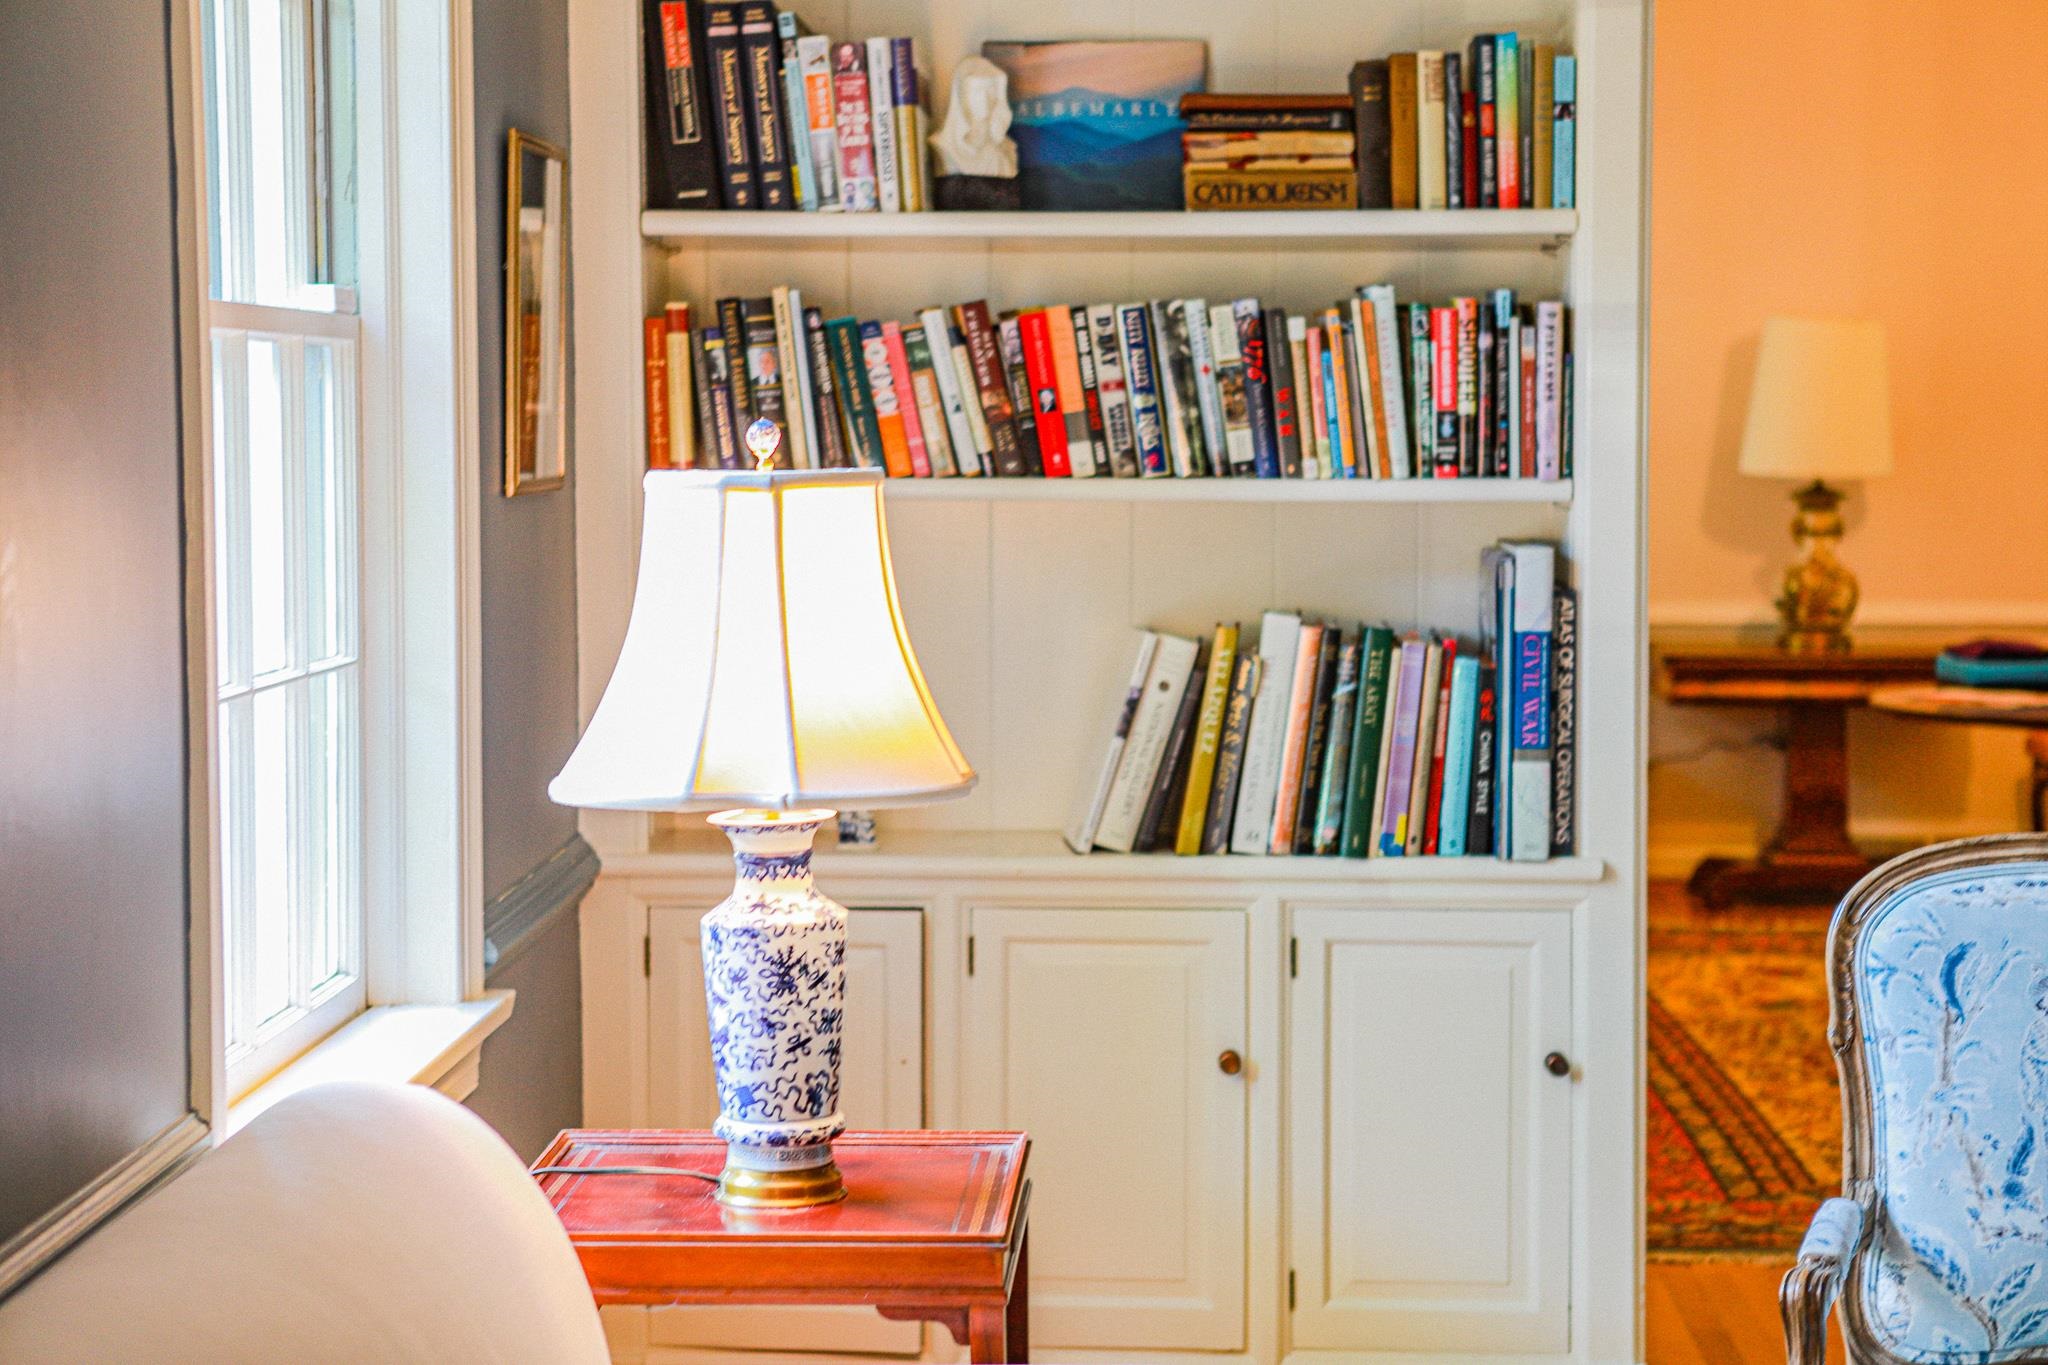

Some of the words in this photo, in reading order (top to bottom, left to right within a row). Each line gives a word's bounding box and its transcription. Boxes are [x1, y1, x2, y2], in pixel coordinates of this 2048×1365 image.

[722, 49, 738, 101] Mastery
[755, 47, 771, 101] Mastery
[1018, 100, 1179, 117] ALBEMARLE
[728, 115, 743, 165] Surgery
[762, 115, 777, 164] Surgery
[1193, 181, 1348, 204] CATHOLICISM
[965, 309, 992, 387] FRIGATES
[982, 330, 996, 359] SIX
[1096, 316, 1119, 367] D-DAY
[1241, 339, 1268, 384] 1776
[1547, 324, 1555, 401] FIREARMS
[1275, 386, 1294, 438] WAR
[1559, 598, 1574, 644] ATLAS
[1367, 648, 1385, 679] THE
[1521, 634, 1542, 692] CIVIL
[1558, 647, 1574, 669] OF
[1363, 684, 1382, 725] ARMY
[1522, 697, 1541, 746] WAR
[1557, 672, 1573, 746] SURGICAL
[1478, 731, 1493, 774] CHINA
[1475, 779, 1489, 815] STYLE
[1555, 749, 1573, 844] OPERATIONS
